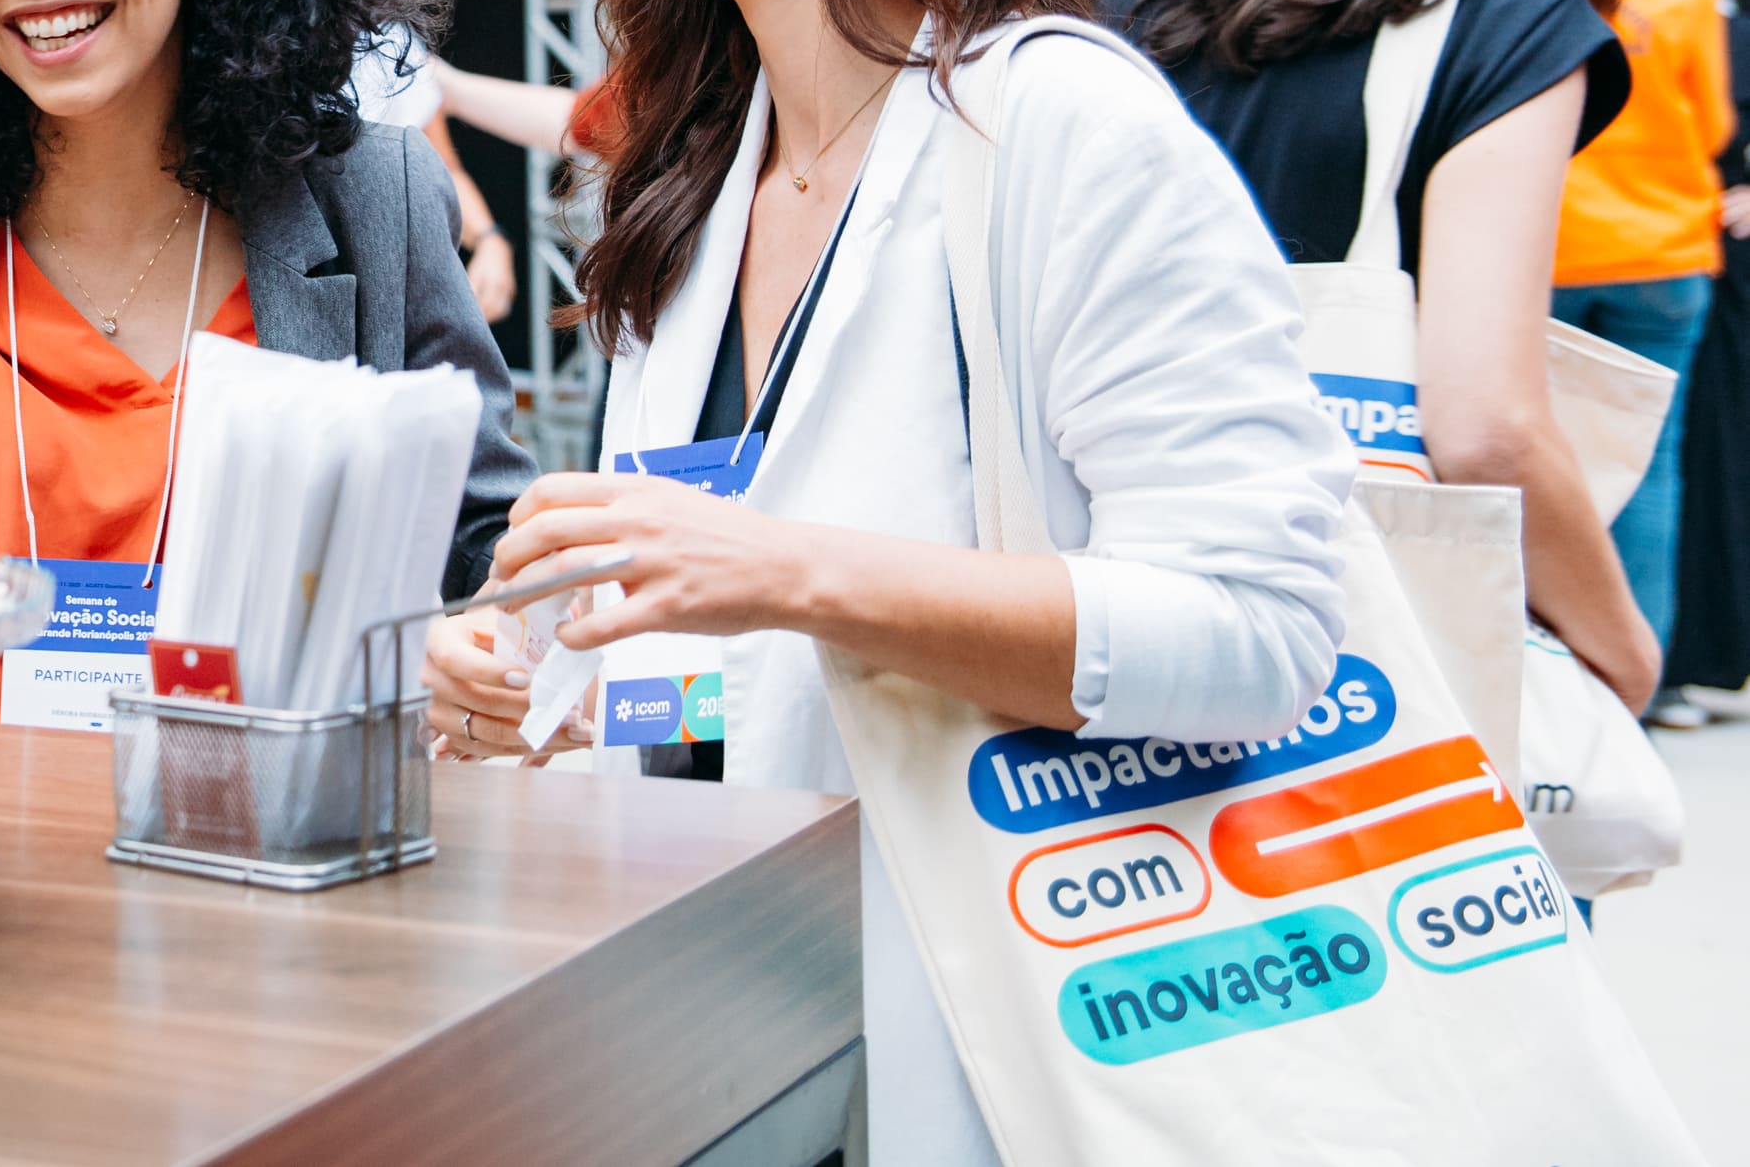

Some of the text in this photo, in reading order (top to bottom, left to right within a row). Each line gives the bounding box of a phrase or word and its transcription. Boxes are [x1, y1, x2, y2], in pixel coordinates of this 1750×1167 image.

[65, 595, 118, 606] Semana de
[107, 609, 155, 627] Socia
[72, 629, 135, 642] Florianópolis
[34, 669, 143, 684] PARTICIPANTE
[1047, 854, 1184, 920] com
[1079, 860, 1561, 1041] inovação social
